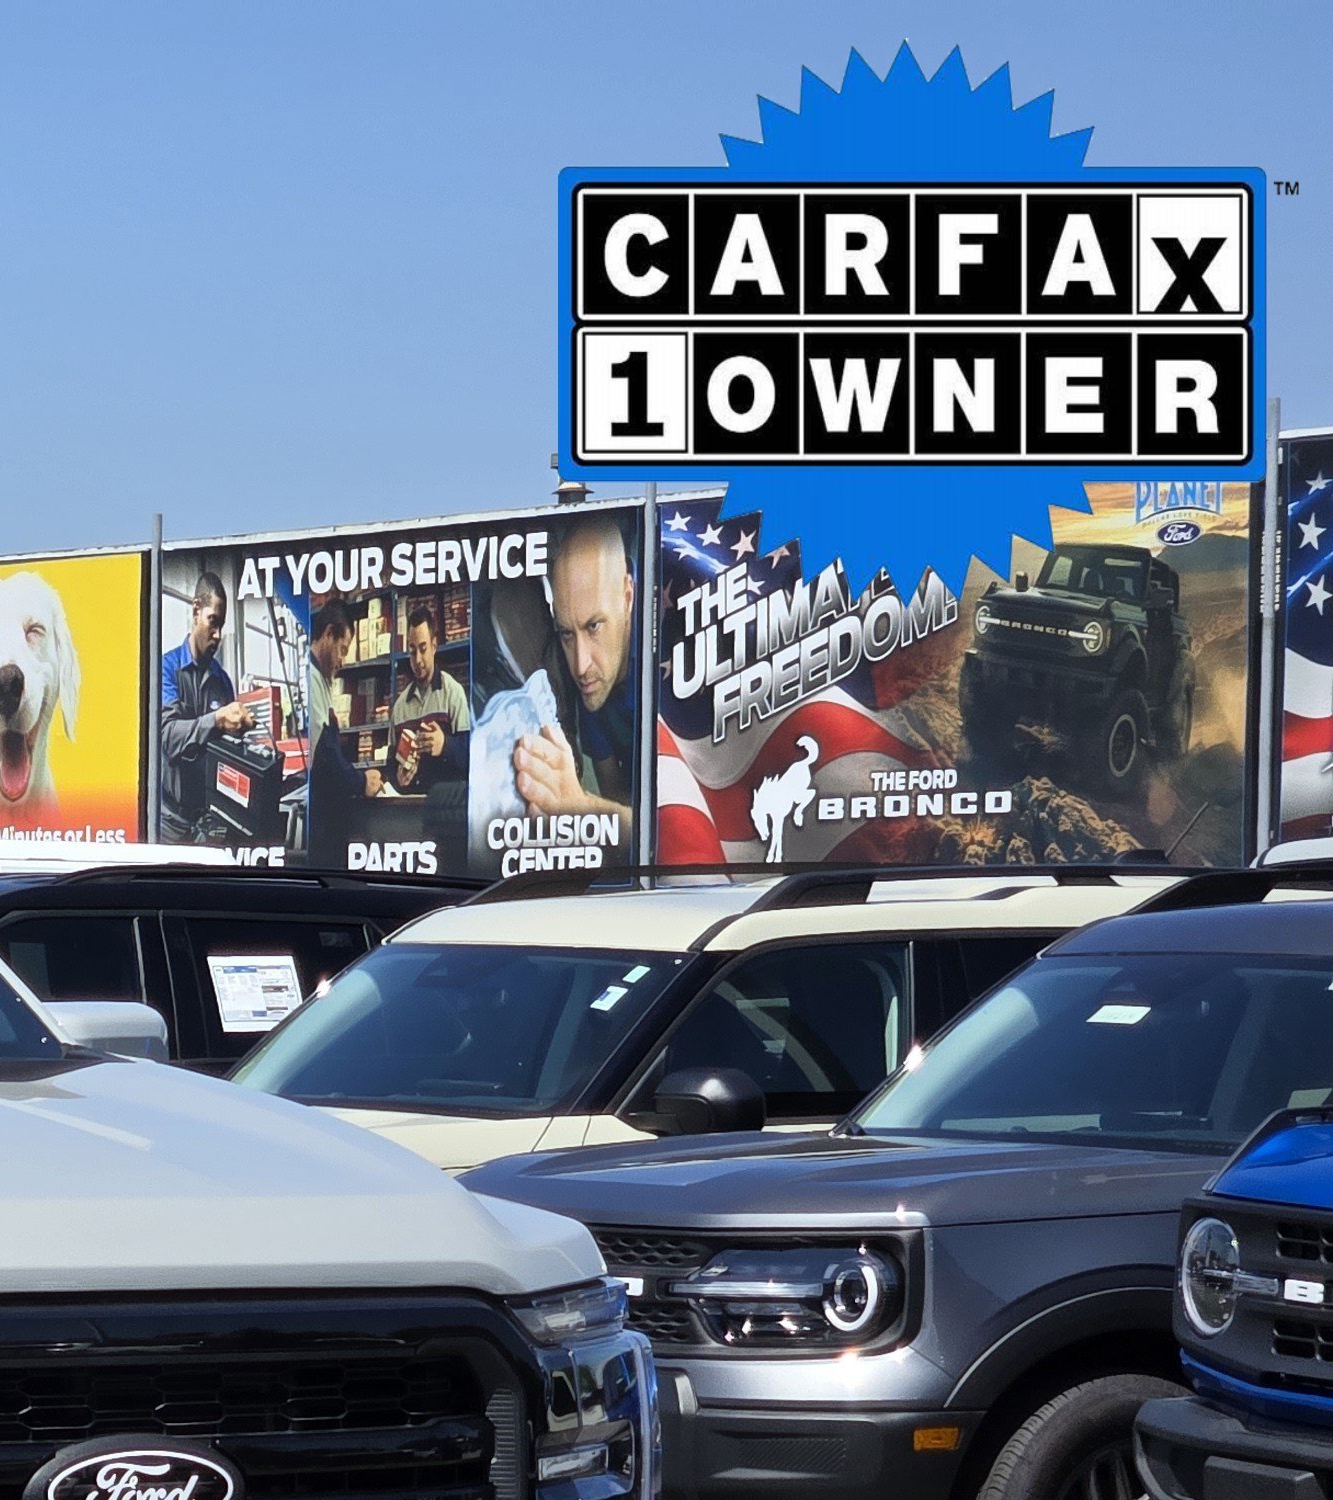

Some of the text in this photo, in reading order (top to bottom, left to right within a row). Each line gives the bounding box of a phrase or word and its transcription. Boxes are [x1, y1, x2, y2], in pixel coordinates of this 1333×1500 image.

[1164, 524, 1194, 541] Ford
[237, 531, 548, 600] AT YOUR SERVICE
[677, 562, 748, 637] THE
[673, 557, 895, 699] ULTIMA
[871, 769, 957, 791] THE FORD
[818, 790, 1012, 820] BRONCO
[487, 813, 619, 850] COLLISION
[348, 841, 438, 875] PARTS
